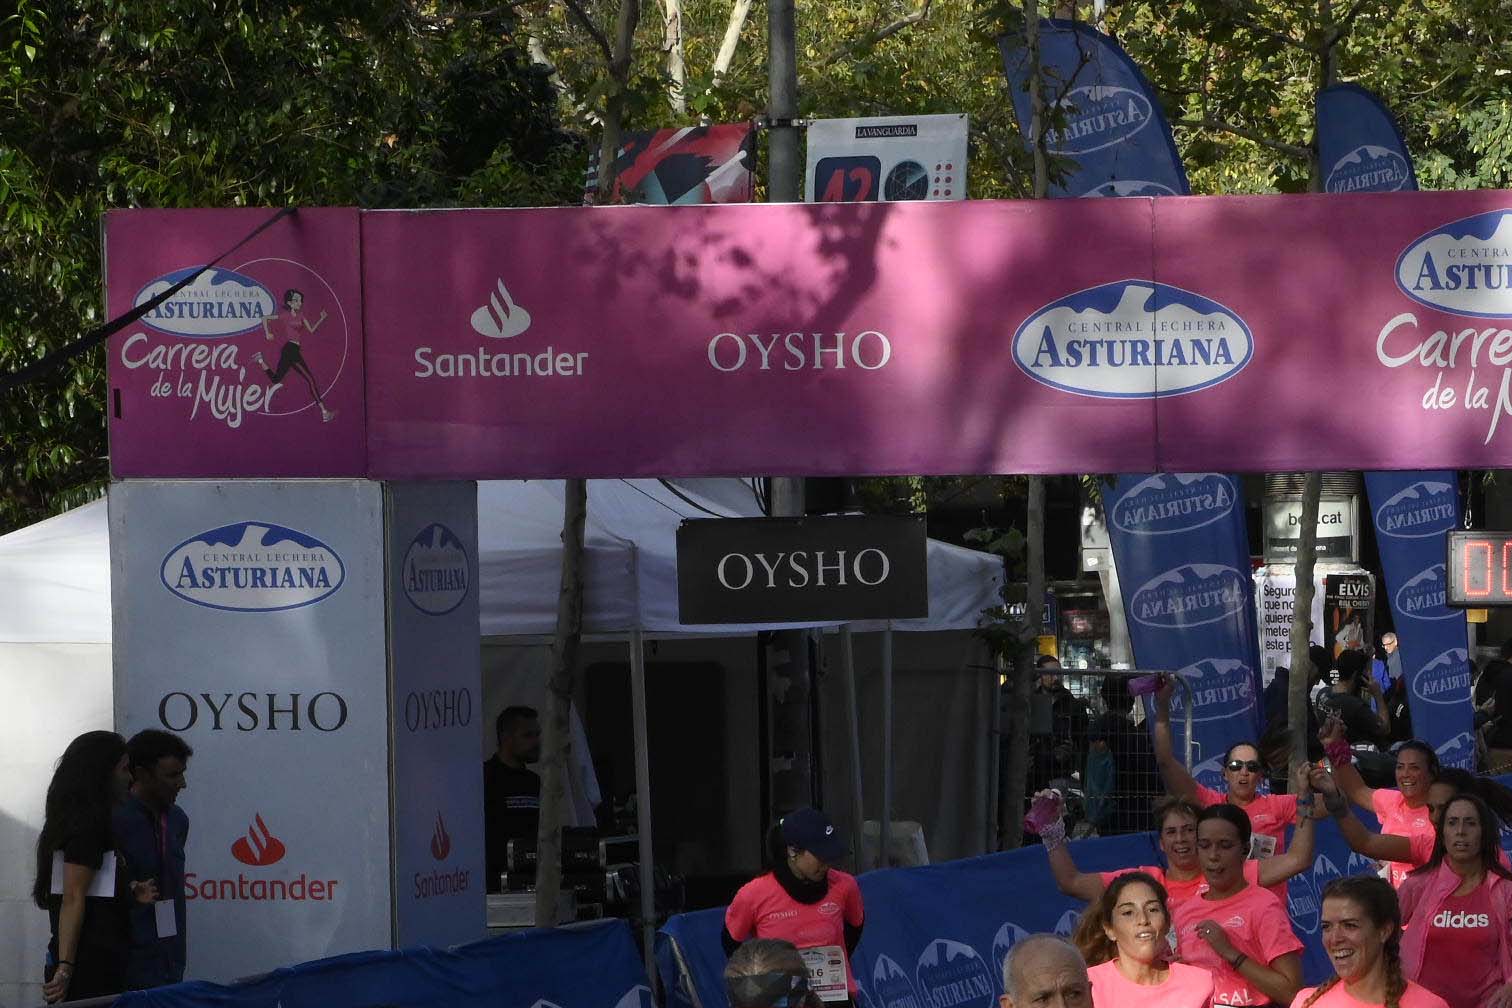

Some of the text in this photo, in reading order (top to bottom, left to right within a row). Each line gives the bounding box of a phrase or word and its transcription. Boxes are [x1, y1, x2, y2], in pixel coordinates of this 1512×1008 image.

[857, 126, 916, 137] LA VANGUARDIA
[145, 292, 266, 319] ASTURIANA
[1068, 319, 1226, 334] CENTRAL LECHERA
[121, 332, 240, 369] Carrera
[708, 331, 892, 373] OYSHO
[1031, 324, 1234, 368] ASTURIANA
[414, 347, 589, 378] Santander
[151, 366, 283, 428] de la Mujer
[1422, 371, 1456, 410] de
[1464, 370, 1489, 409] la
[175, 555, 332, 589] ASTURIANA
[203, 553, 325, 563] CENTRAL LECHERA
[717, 548, 890, 590] OYSHO
[407, 557, 466, 593] ASTURIANA
[1339, 584, 1369, 596] ELVIS
[1265, 600, 1280, 613] que
[1265, 613, 1293, 624] quiere
[1266, 640, 1284, 650] este
[158, 692, 348, 732] OYSHO
[405, 688, 472, 733] OYSHO
[184, 873, 338, 901] Santander
[414, 869, 470, 899] Santander
[1433, 911, 1489, 929] adidas
